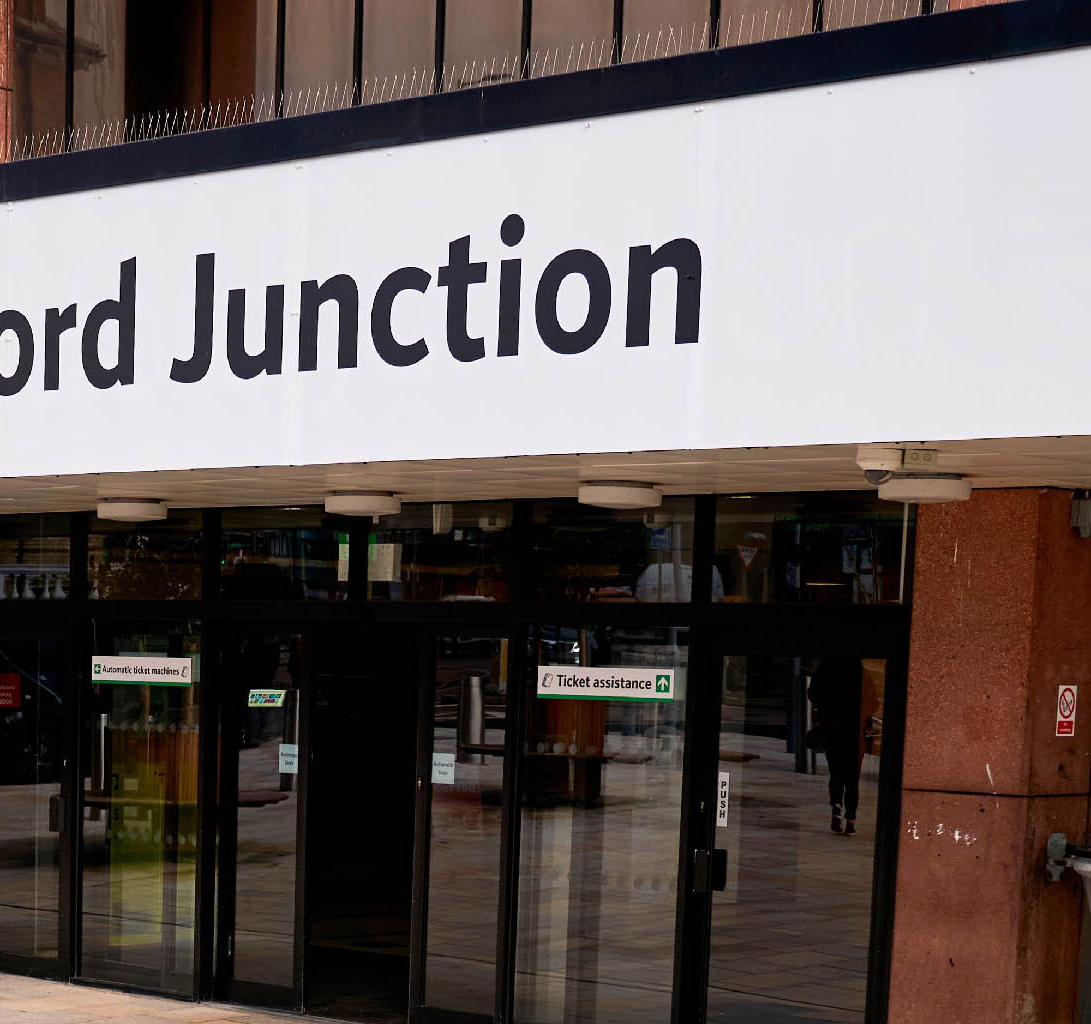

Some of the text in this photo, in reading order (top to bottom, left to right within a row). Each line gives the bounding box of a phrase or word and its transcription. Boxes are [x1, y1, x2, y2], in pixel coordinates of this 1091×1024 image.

[169, 213, 702, 384] Junction
[102, 665, 180, 676] Automatic ticket machines
[556, 674, 652, 690] Ticket assistance
[719, 781, 727, 819] PUSH
